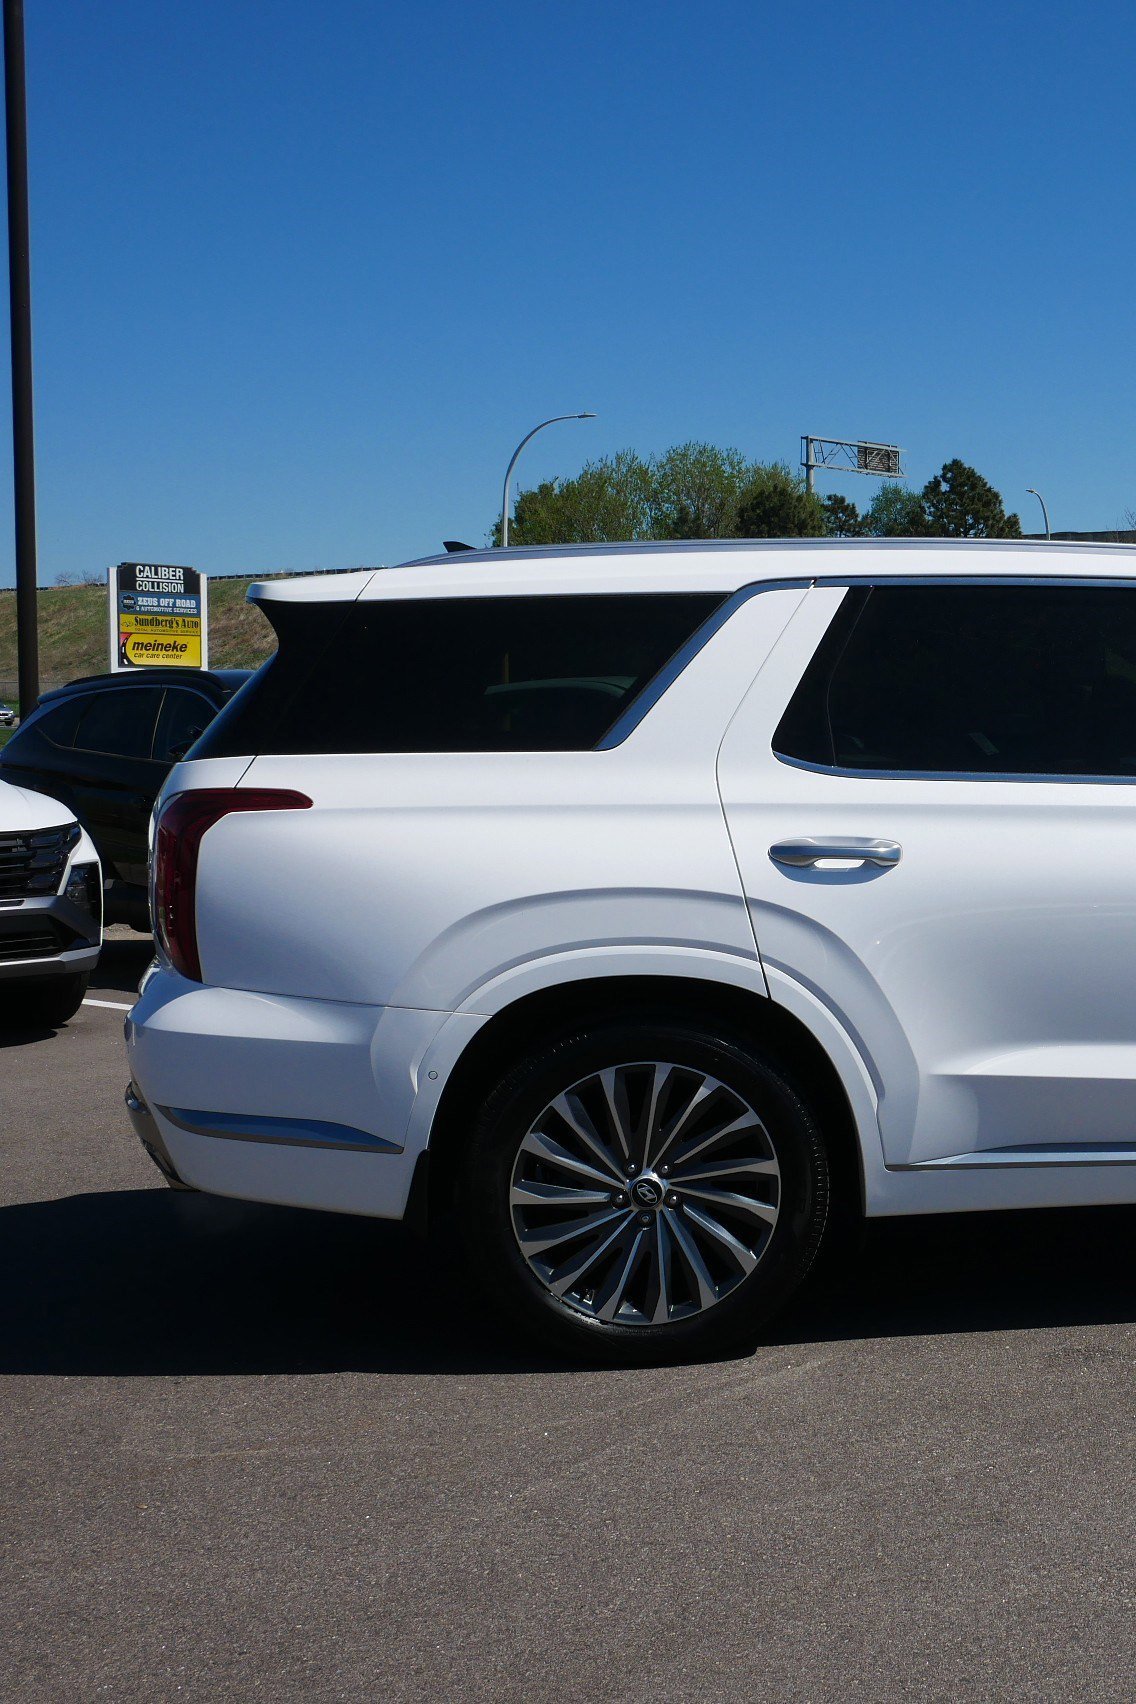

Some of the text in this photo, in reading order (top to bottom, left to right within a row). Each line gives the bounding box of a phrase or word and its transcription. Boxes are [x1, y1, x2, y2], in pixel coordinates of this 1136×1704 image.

[136, 565, 184, 580] CALIBER
[136, 581, 184, 593] COLLISION
[137, 597, 196, 608] ZEUS OFF ROAD
[134, 616, 180, 629] Sundberg's
[132, 640, 187, 653] meineke
